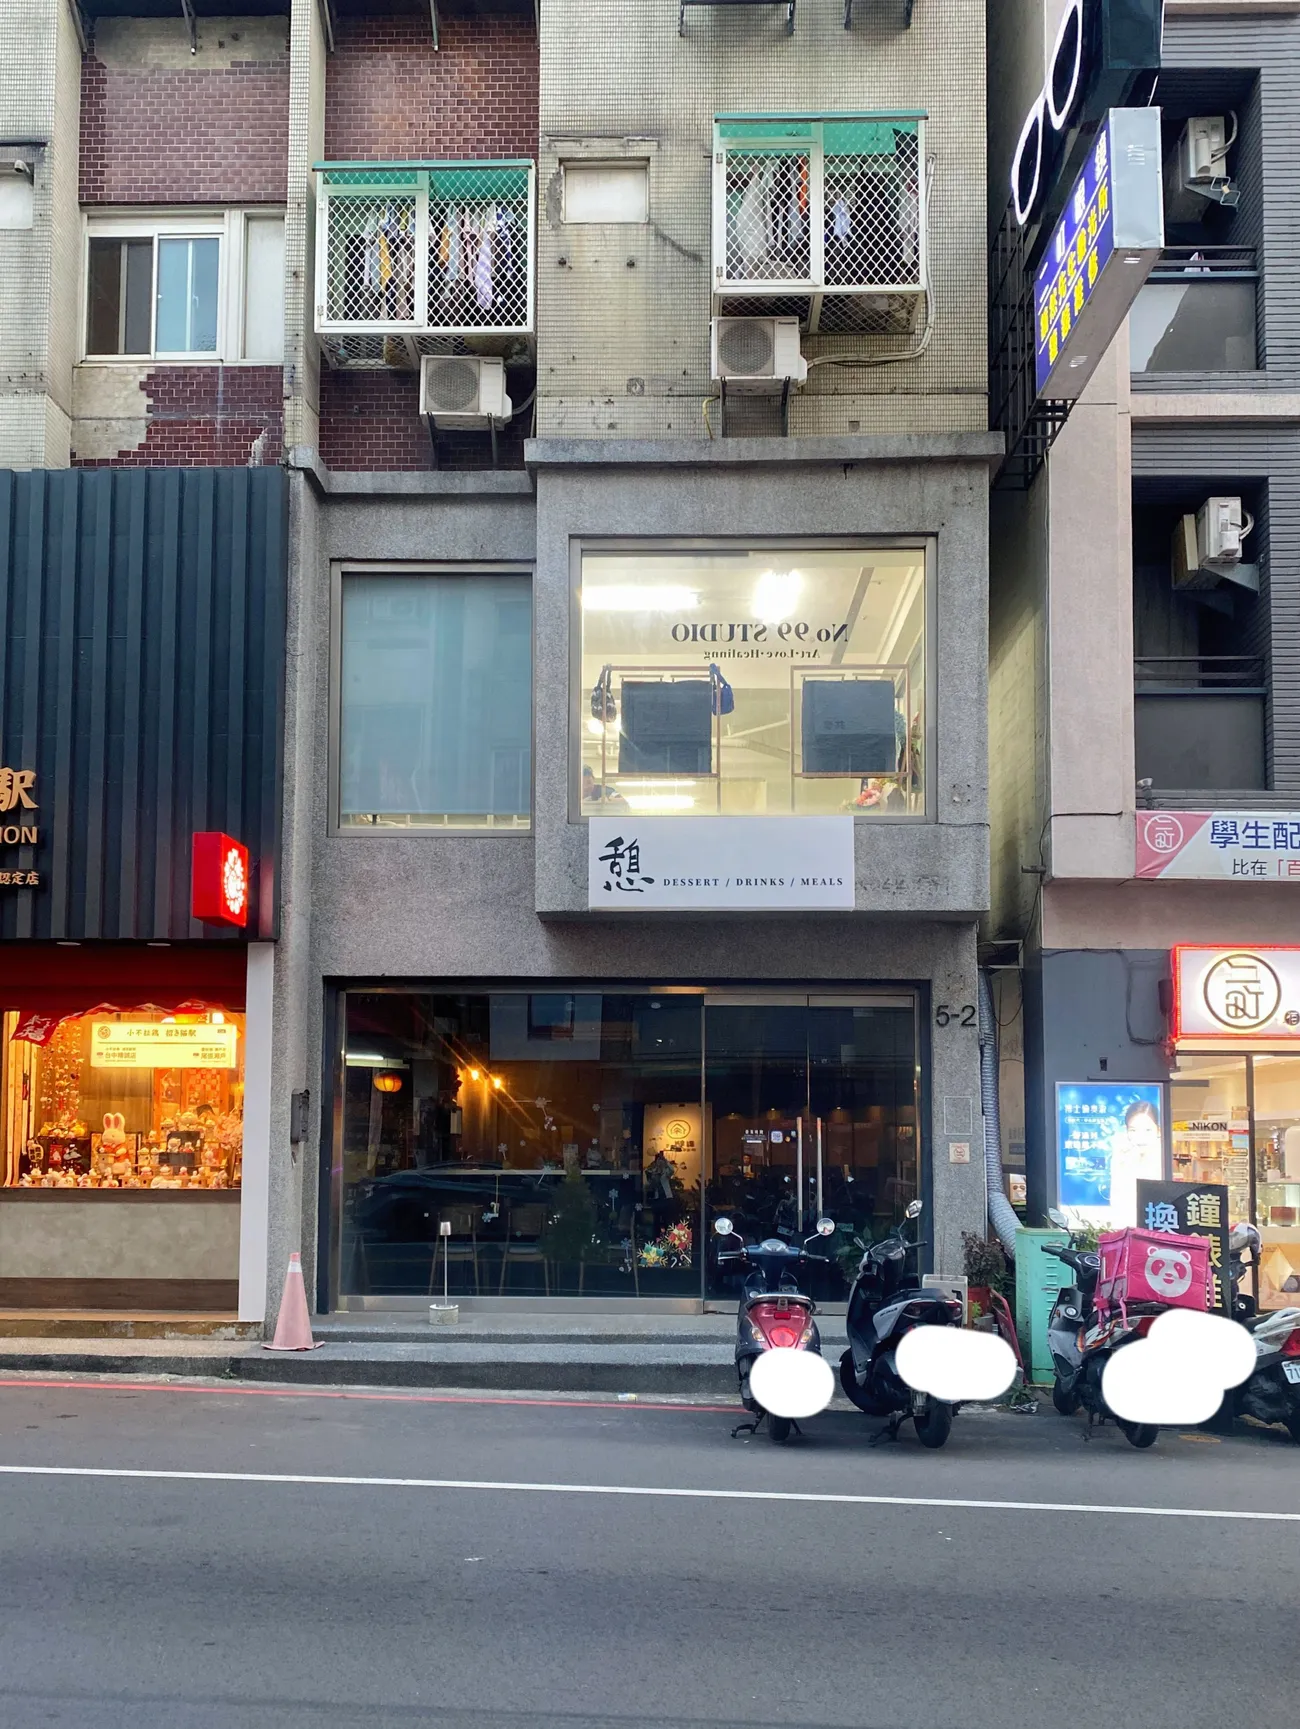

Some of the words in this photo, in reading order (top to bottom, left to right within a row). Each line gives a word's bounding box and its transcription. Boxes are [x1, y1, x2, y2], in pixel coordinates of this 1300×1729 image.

[598, 836, 655, 893] 憩
[662, 877, 720, 888] DESSERT
[735, 877, 786, 888] DRINKS
[800, 877, 844, 888] MEALS
[936, 1004, 977, 1028] 5-2
[1191, 1121, 1228, 1132] NIKON
